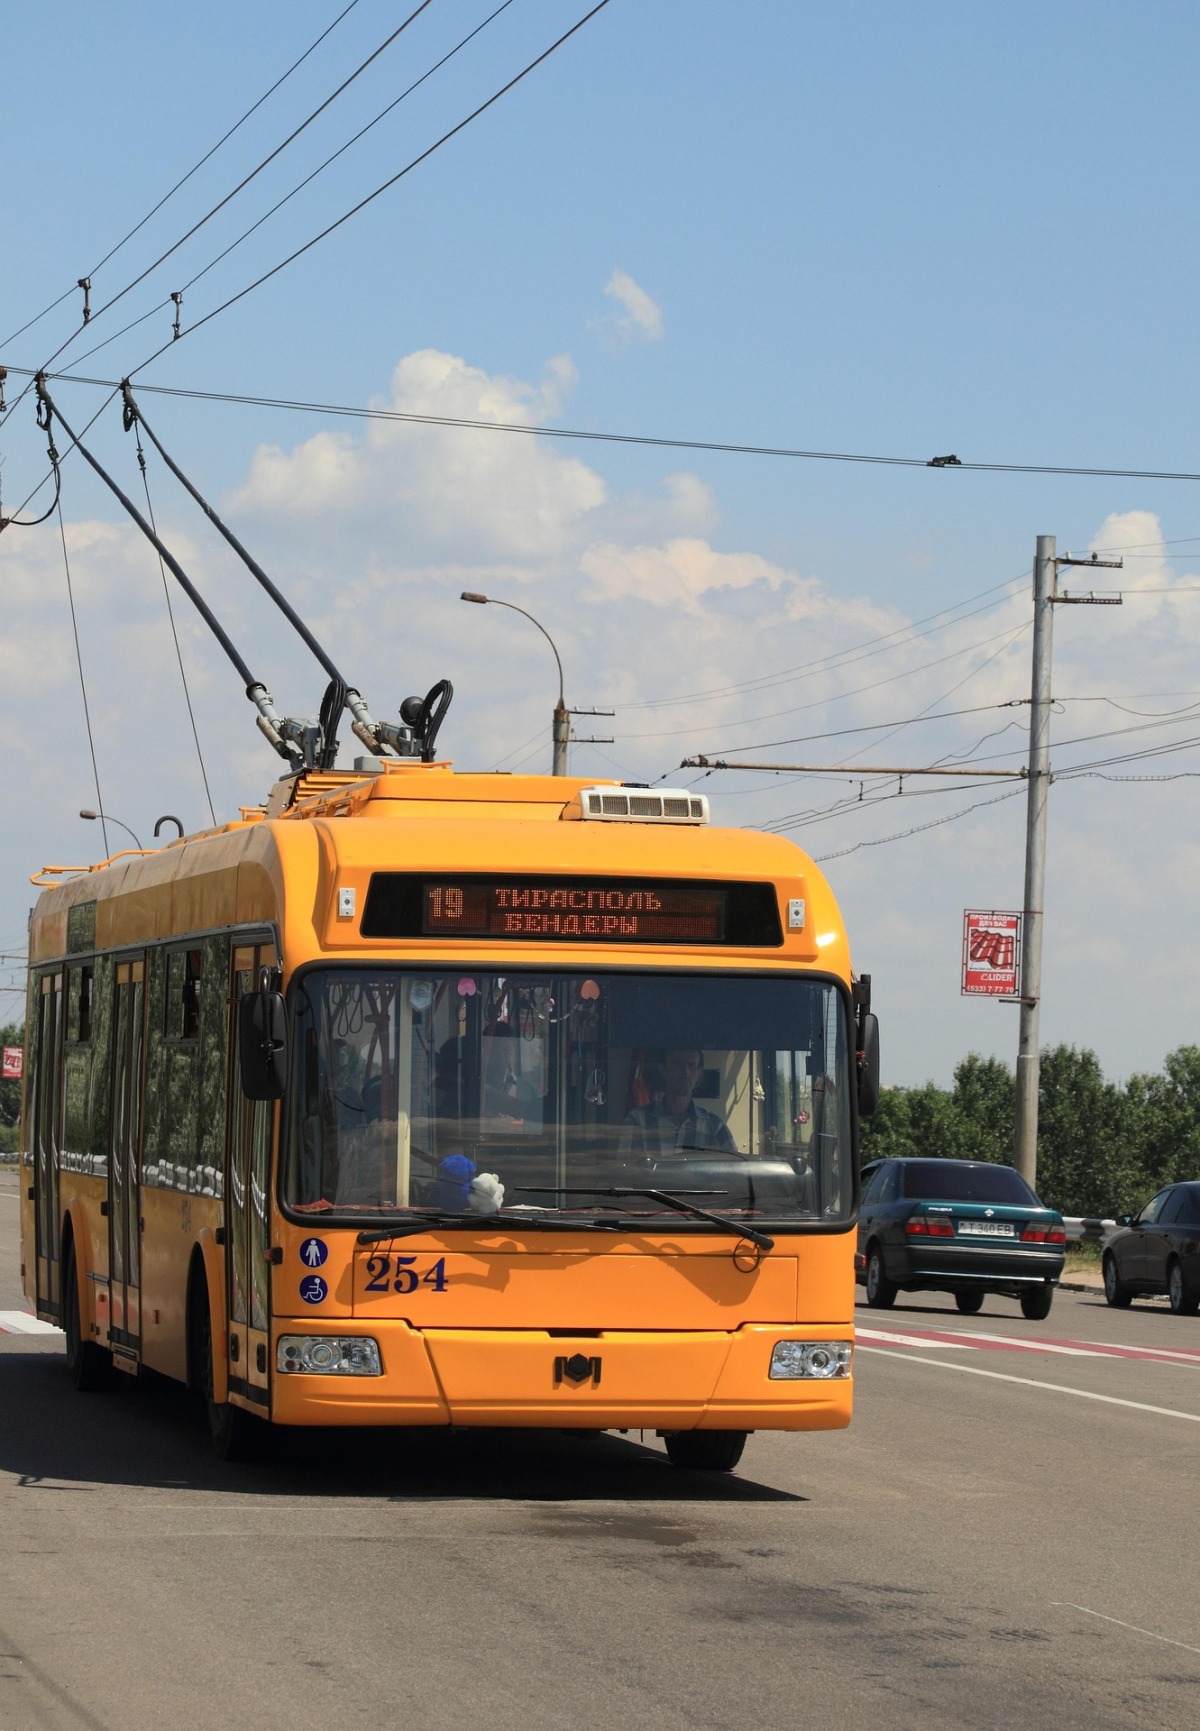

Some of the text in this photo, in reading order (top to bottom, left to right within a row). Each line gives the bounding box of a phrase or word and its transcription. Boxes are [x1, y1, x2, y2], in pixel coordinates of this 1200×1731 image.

[429, 887, 464, 918] 19
[495, 888, 661, 911] ТИРАСПОЛЬ
[504, 913, 638, 935] БЕНДЕРЫ
[988, 973, 1012, 982] LIDER
[968, 1223, 975, 1232] T
[978, 1223, 994, 1234] 340
[365, 1256, 449, 1294] 254
